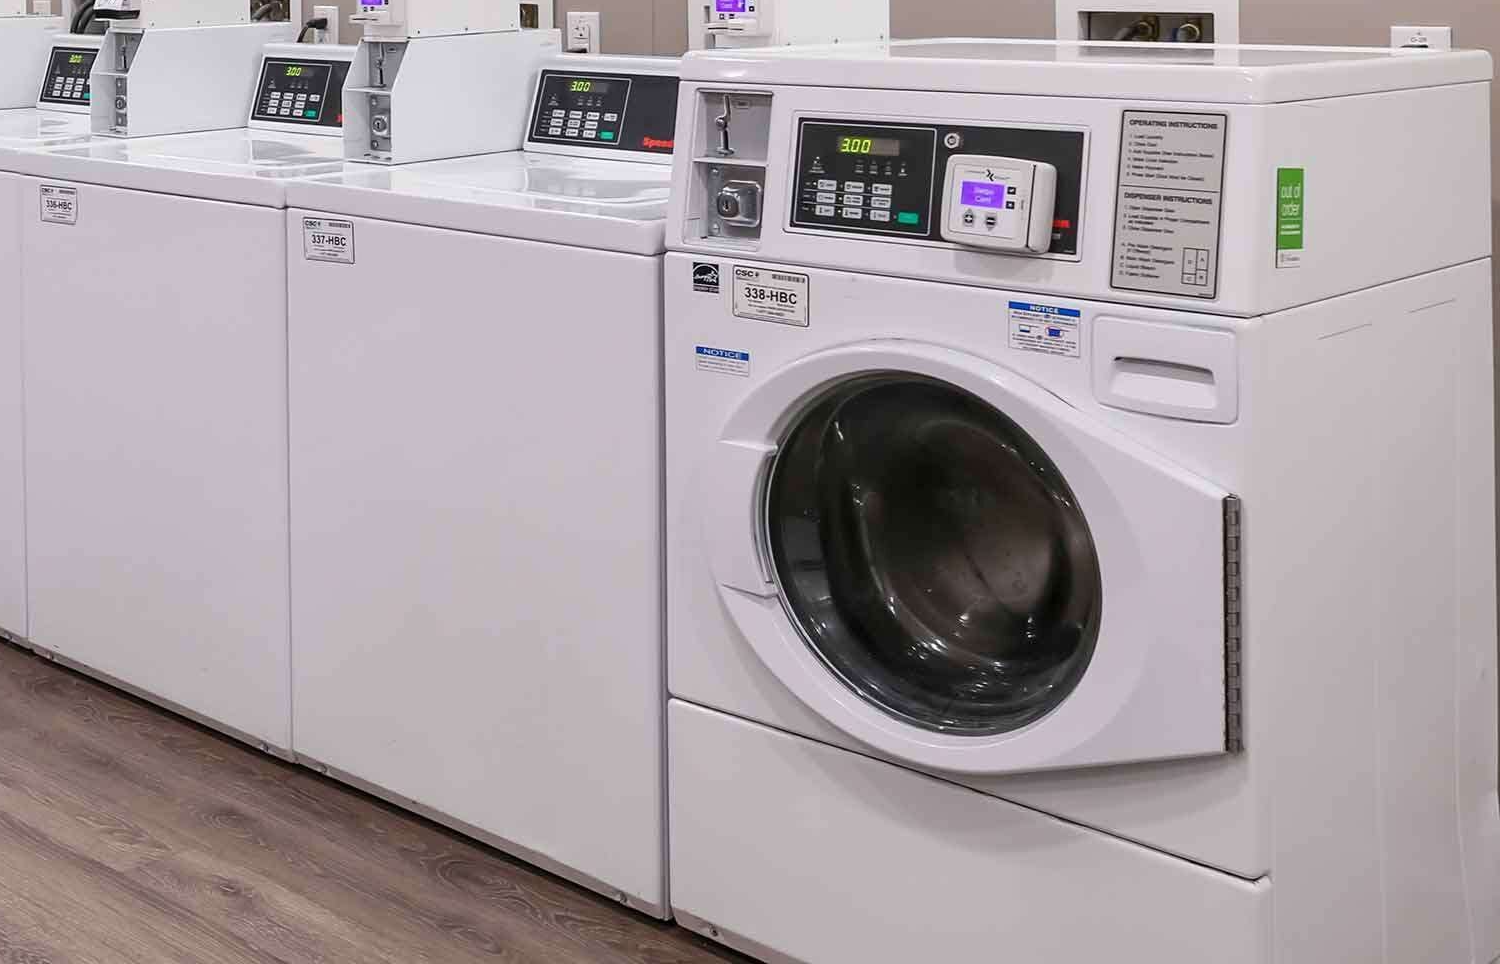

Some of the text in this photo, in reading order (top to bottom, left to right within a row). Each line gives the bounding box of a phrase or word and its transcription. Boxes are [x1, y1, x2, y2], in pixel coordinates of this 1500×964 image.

[570, 81, 591, 92] 3.00
[1129, 119, 1218, 129] OPERATING INSTRUCTIONS
[841, 138, 871, 153] 3.00
[1124, 192, 1212, 204] DISPENSER INSTRUCTIONS
[311, 234, 346, 246] 337-HBC
[735, 269, 754, 277] CSC
[744, 287, 797, 305] 338-HBC
[1029, 304, 1059, 314] NOTICE
[703, 348, 741, 358] NOTICE
